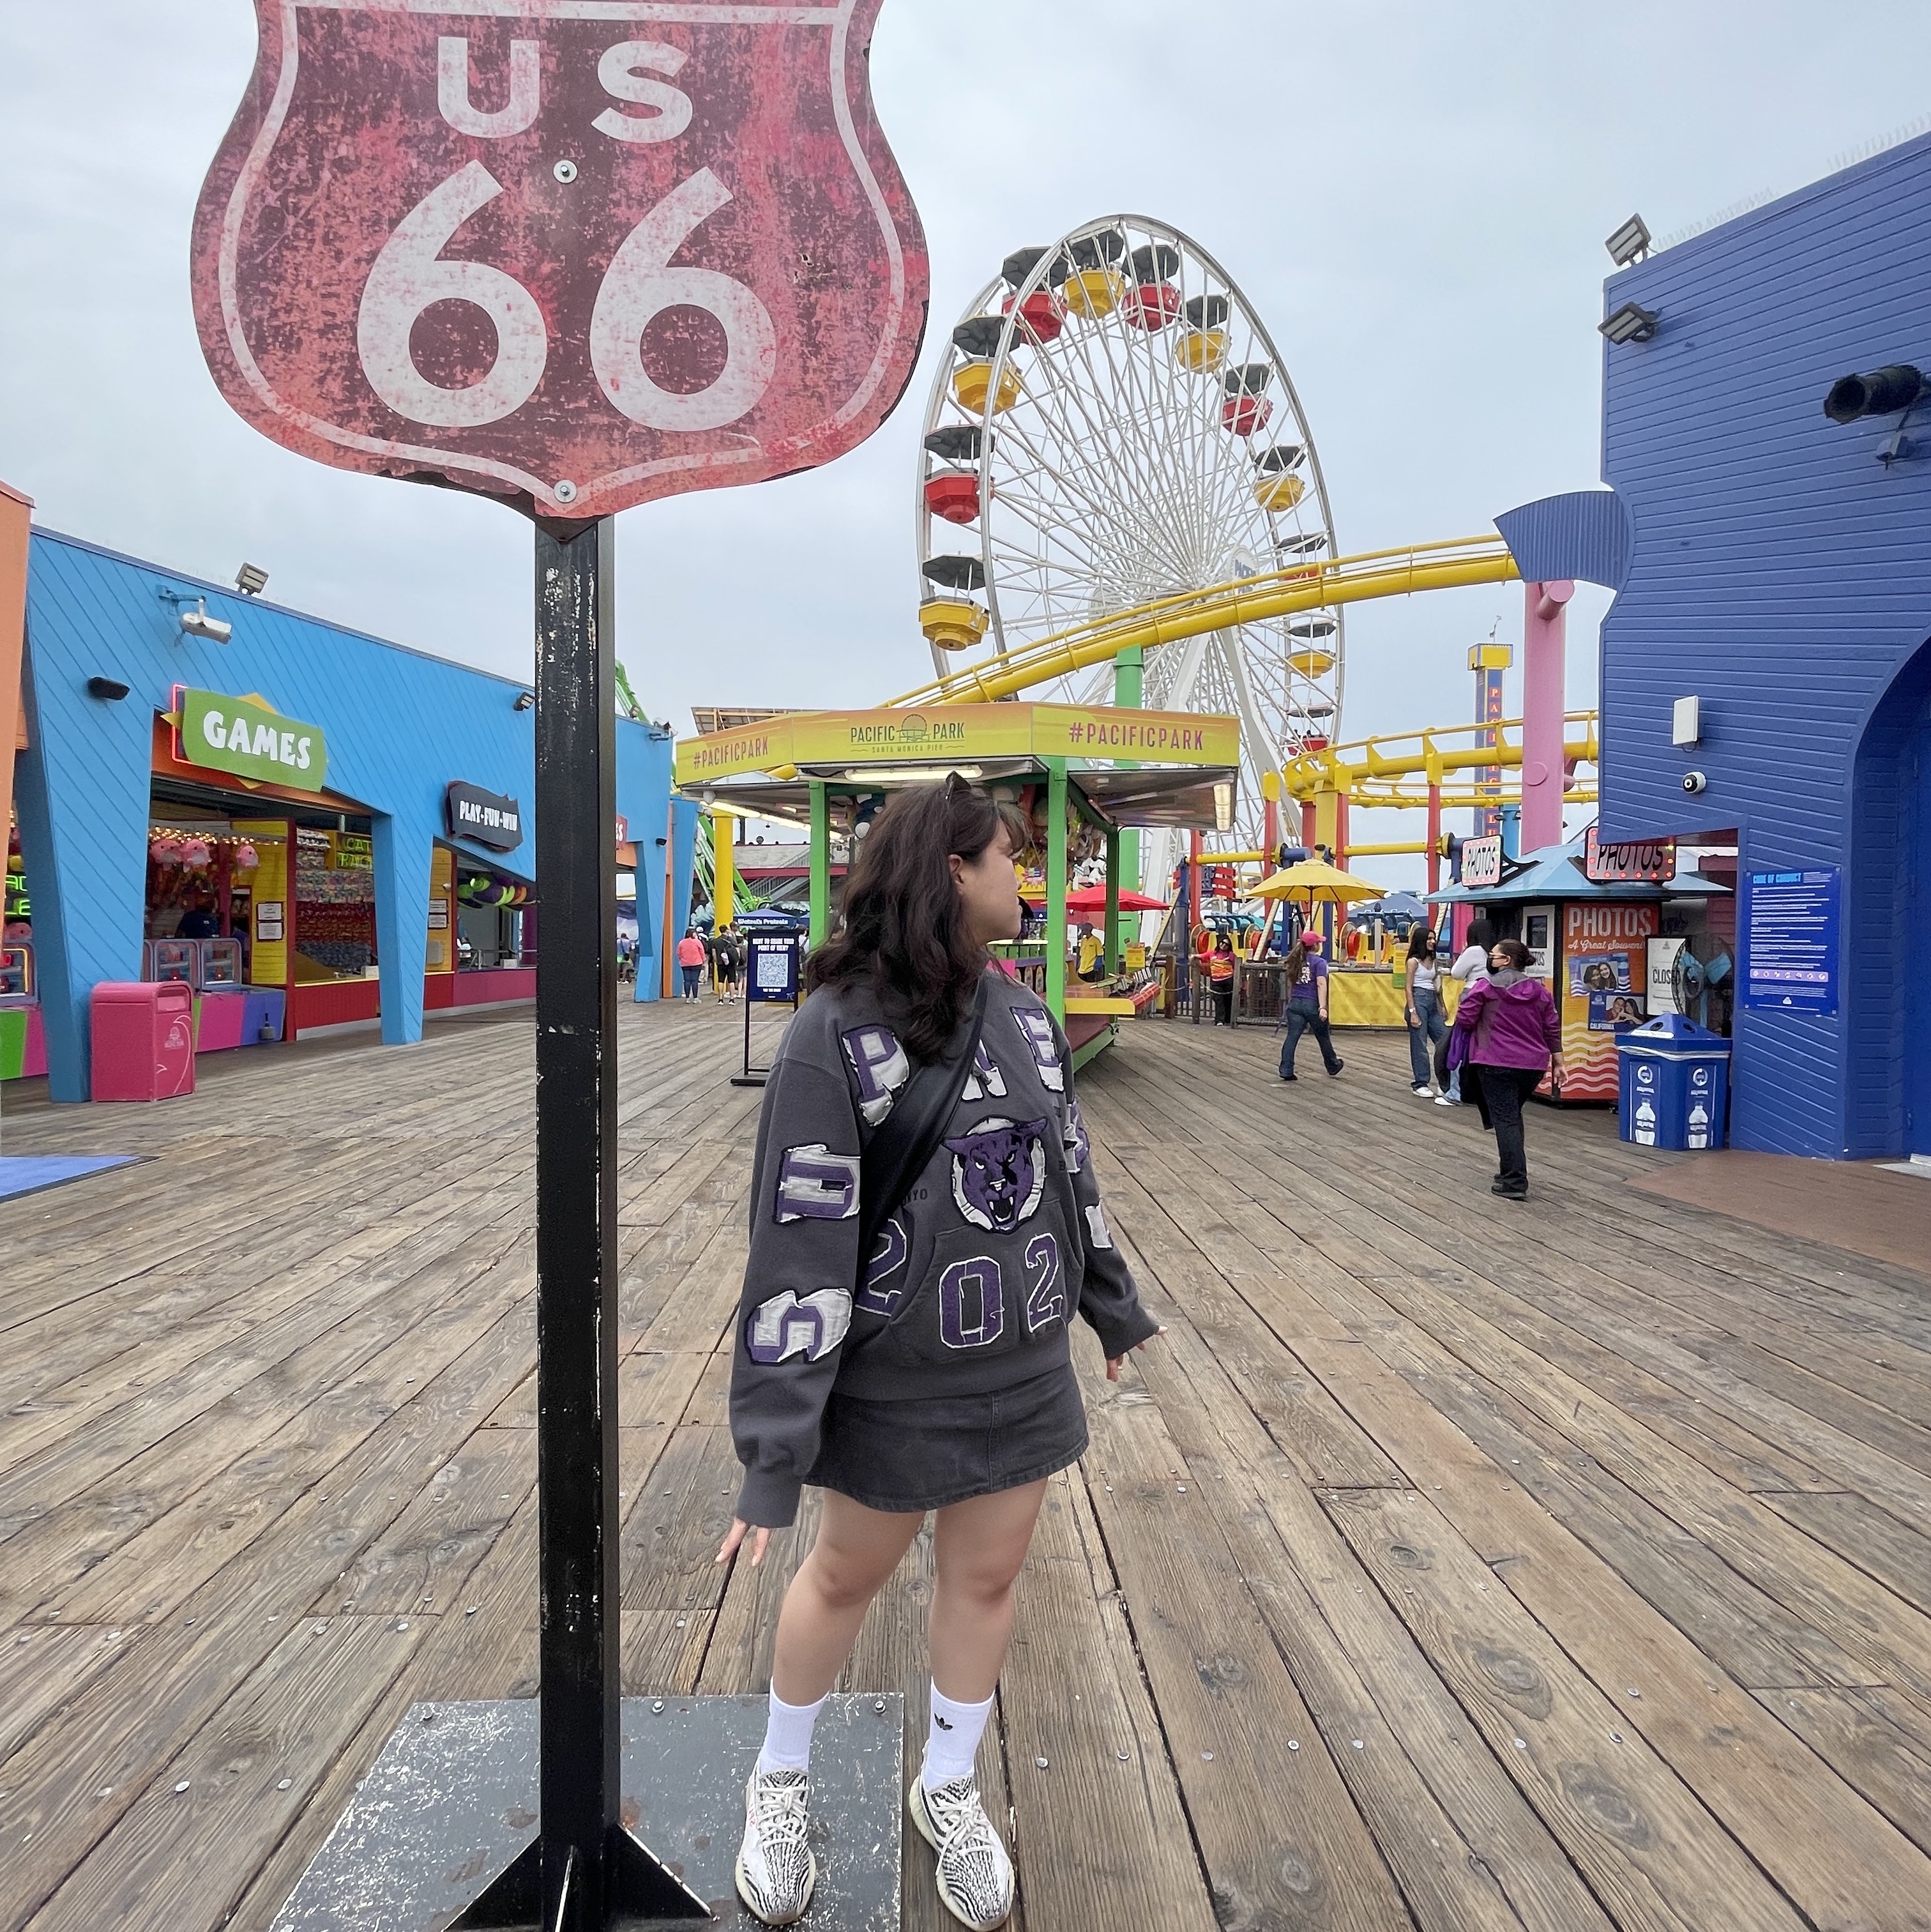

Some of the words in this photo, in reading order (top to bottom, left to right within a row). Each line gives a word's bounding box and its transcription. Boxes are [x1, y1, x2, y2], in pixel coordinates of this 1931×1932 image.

[437, 37, 693, 143] US
[358, 159, 775, 431] 66
[203, 710, 311, 770] GAMES
[851, 726, 895, 743] PACIFIC
[933, 722, 965, 740] PARK
[1068, 722, 1204, 750] #PACIFICPARK
[693, 736, 769, 770] #PACIFICPARK
[1568, 907, 1651, 937] PHOTOS
[1580, 939, 1607, 952] Great
